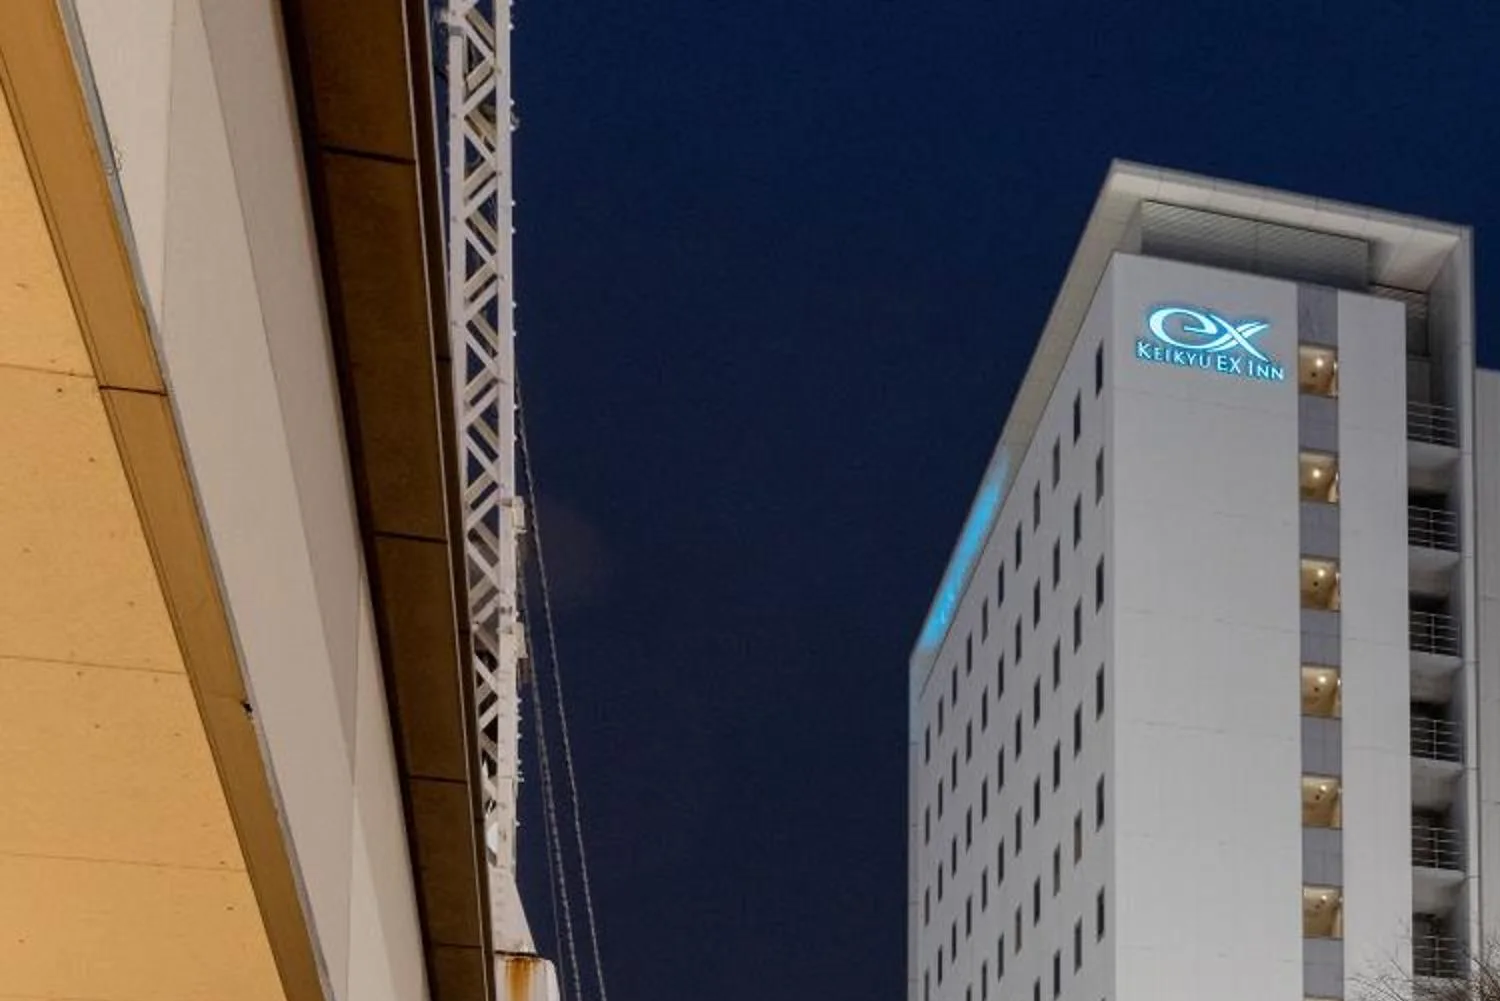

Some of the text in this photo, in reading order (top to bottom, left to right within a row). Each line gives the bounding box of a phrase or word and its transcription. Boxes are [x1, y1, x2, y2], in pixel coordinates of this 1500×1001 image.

[1137, 342, 1284, 380] KEIKYU EX INN
